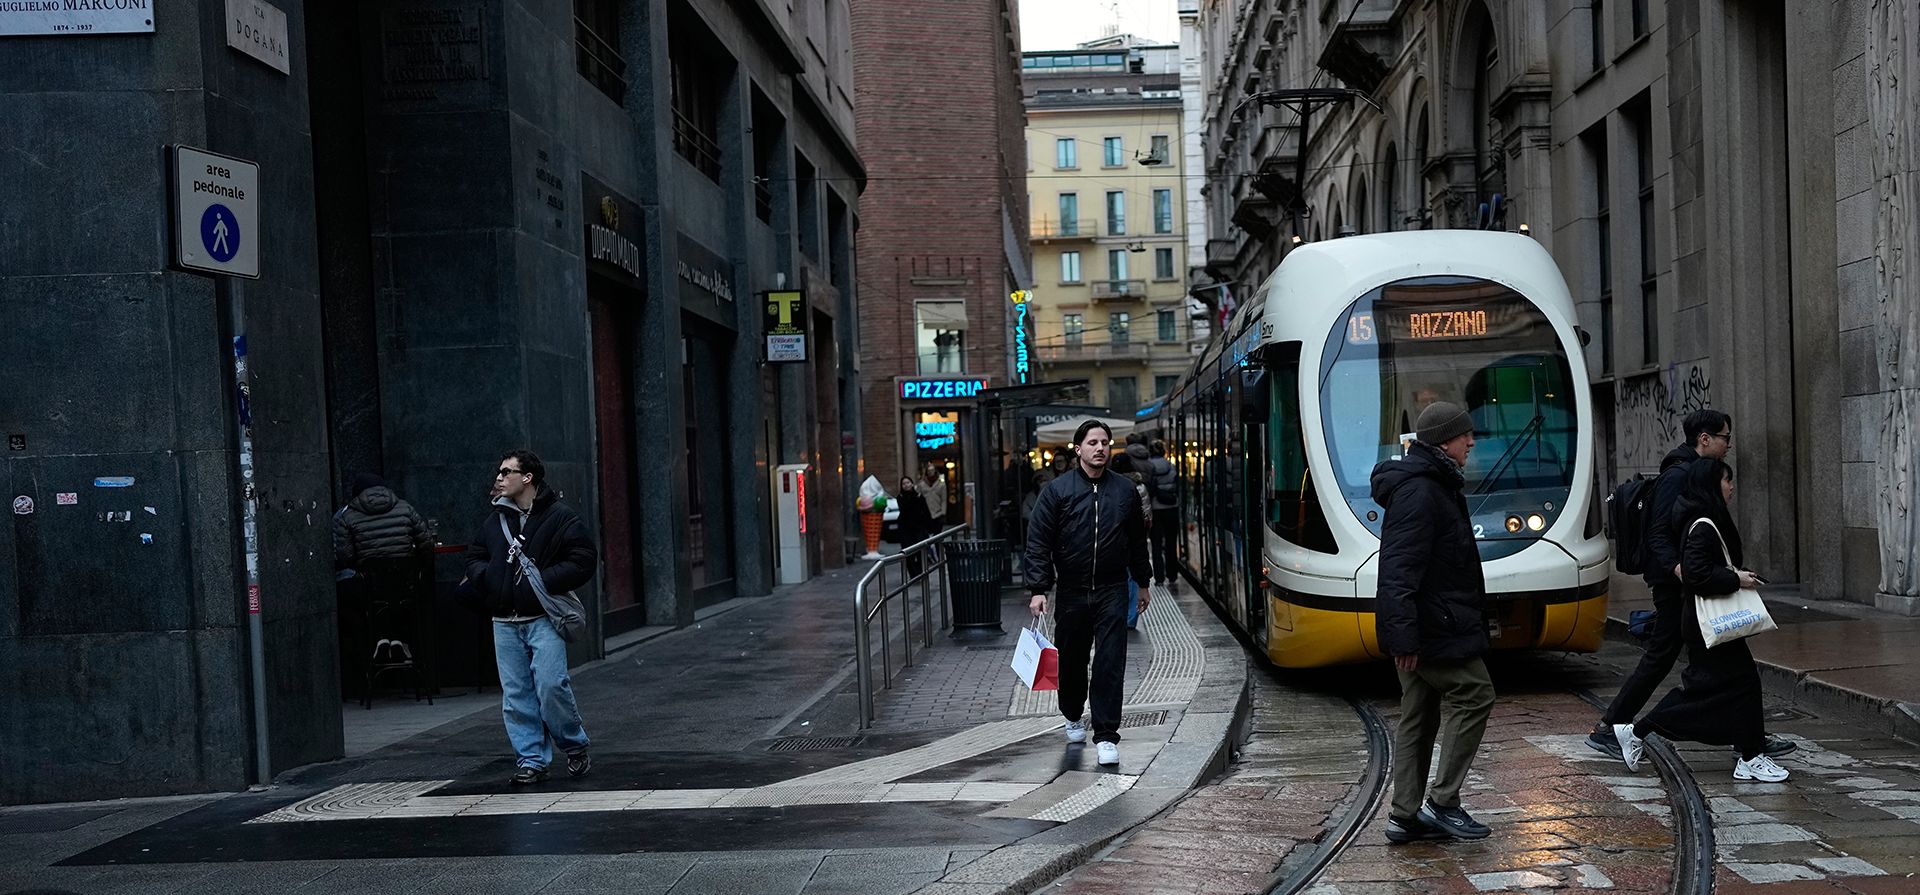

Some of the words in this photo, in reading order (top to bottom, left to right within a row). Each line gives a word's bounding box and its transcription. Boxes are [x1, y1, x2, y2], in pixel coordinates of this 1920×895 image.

[63, 0, 147, 10] MARCONI
[253, 4, 265, 19] VIA
[236, 18, 284, 57] DOGANA
[206, 164, 231, 179] area
[193, 180, 245, 200] pedonale
[768, 292, 801, 323] T
[1349, 315, 1372, 341] 15
[1410, 310, 1487, 338] ROZZANO
[904, 380, 983, 398] PIZZERIA
[1035, 414, 1075, 424] DOGAN
[1709, 608, 1752, 626] SLOWNESS
[1713, 625, 1722, 635] IS
[1724, 623, 1731, 631] A
